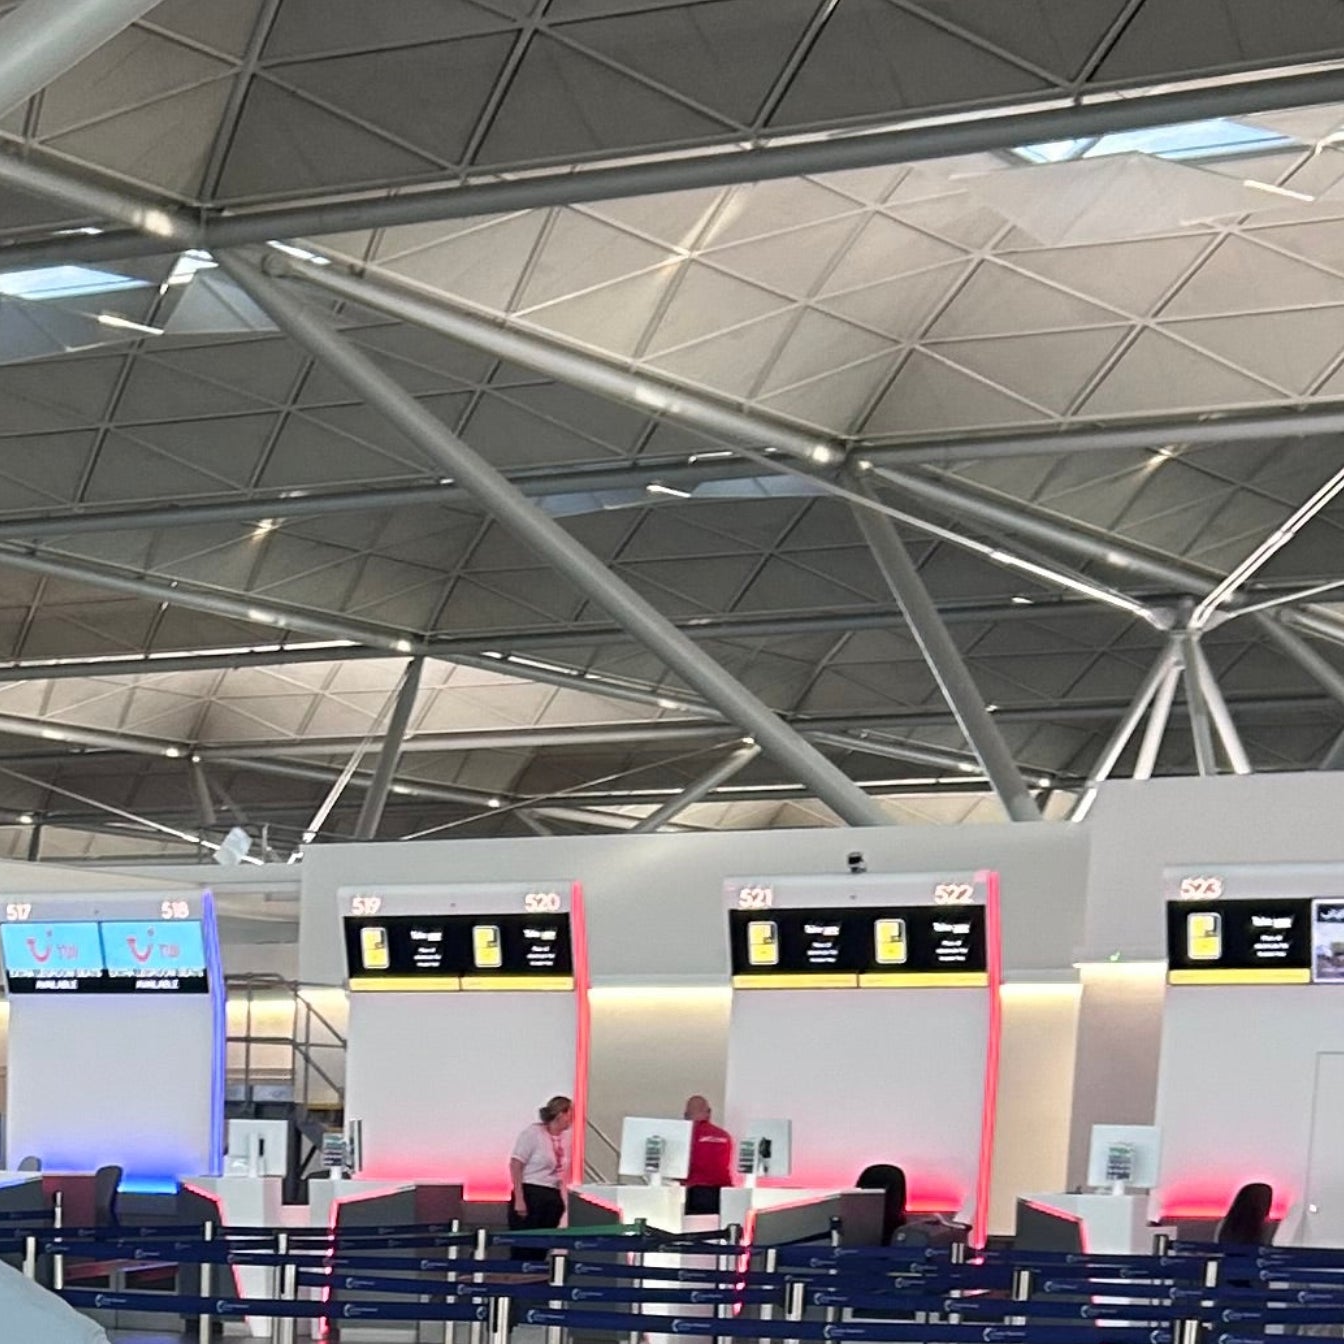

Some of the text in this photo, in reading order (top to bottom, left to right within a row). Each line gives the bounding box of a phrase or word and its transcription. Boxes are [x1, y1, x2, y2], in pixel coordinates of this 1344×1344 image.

[934, 885, 974, 904] 522
[1180, 876, 1223, 900] 523
[351, 897, 381, 915] 519
[524, 893, 561, 911] 520
[738, 888, 774, 908] 521
[5, 903, 32, 920] 517
[160, 901, 190, 918] 518
